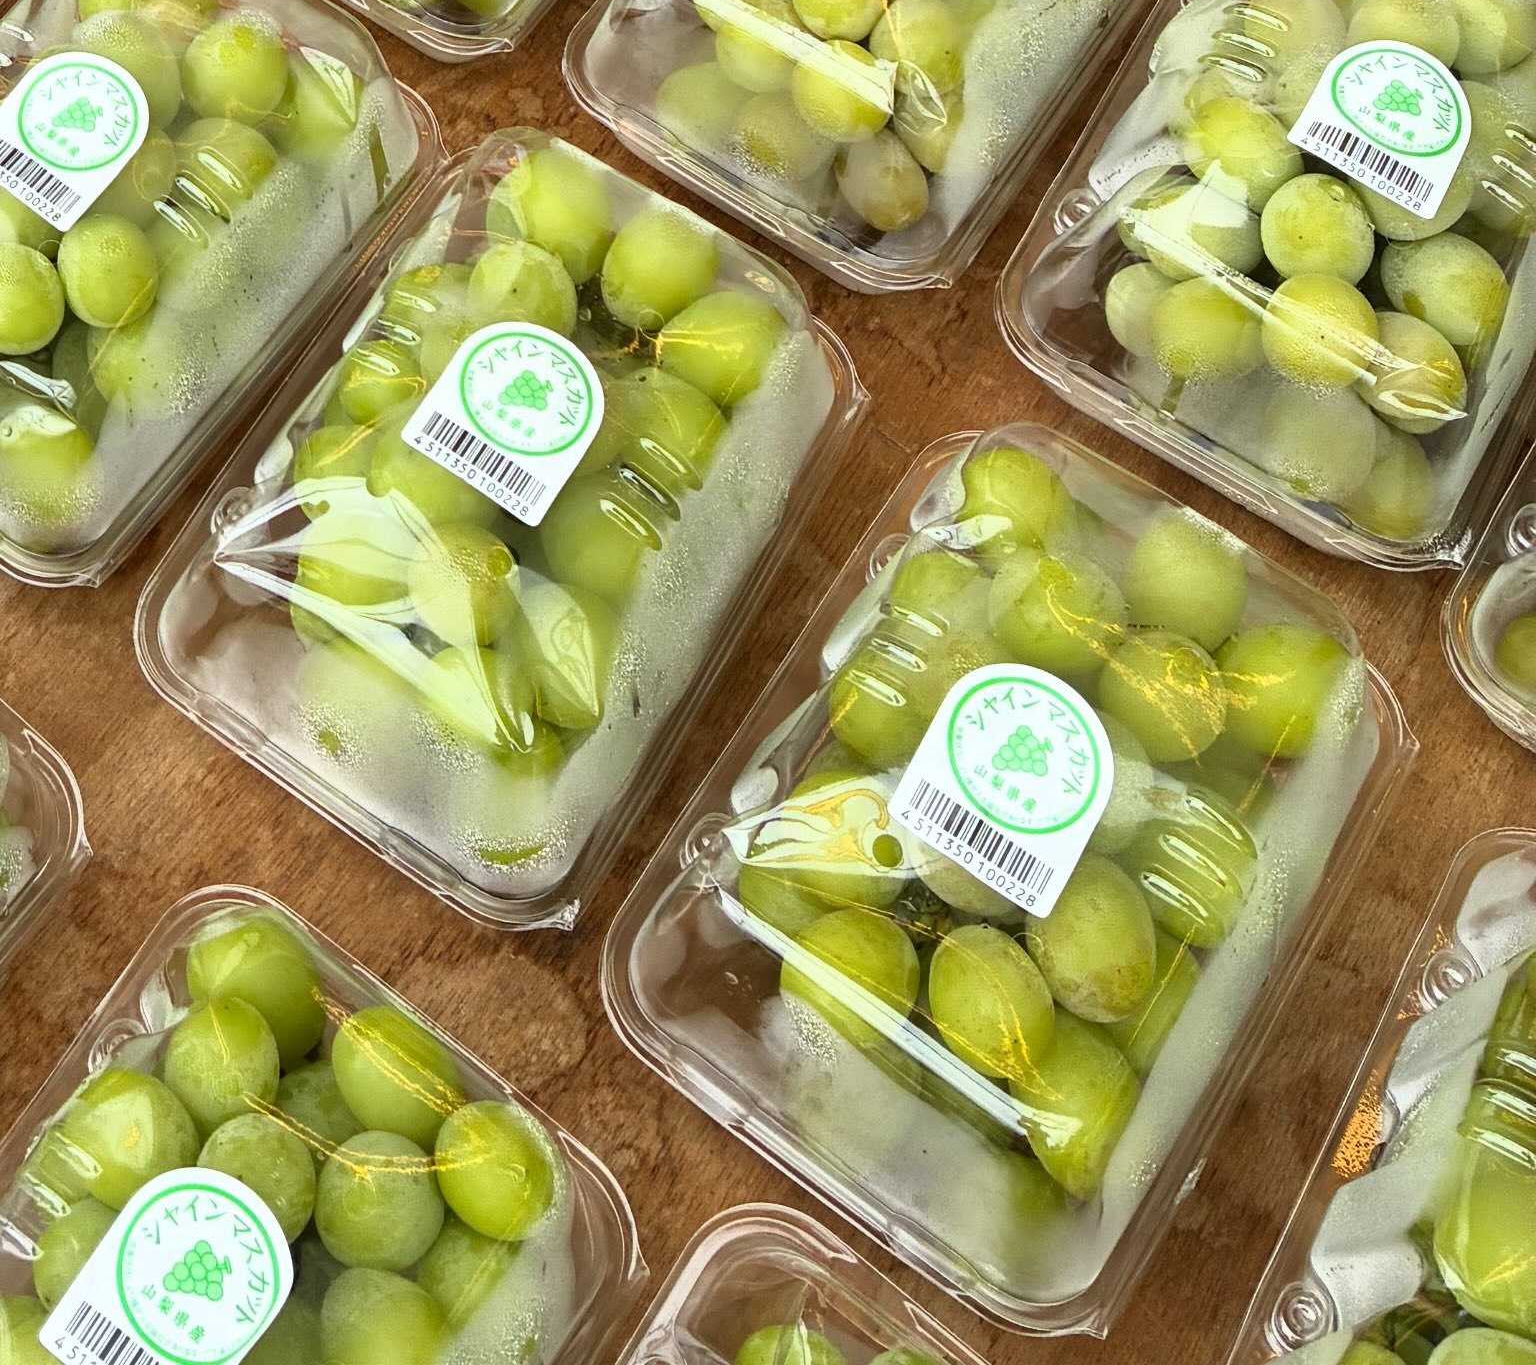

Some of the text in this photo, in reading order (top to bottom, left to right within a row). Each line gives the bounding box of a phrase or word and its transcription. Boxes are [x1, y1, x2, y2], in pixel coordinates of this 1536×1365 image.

[39, 72, 133, 148] シャインマスカット
[1345, 54, 1454, 134] シャインマスカット
[1357, 105, 1417, 142] 山梨県産
[33, 121, 81, 158] 山梨県産
[476, 340, 588, 428] シャインマスカット
[480, 398, 537, 437] 山梨県産
[964, 686, 1091, 796] シャインマスカット
[974, 763, 1038, 814] 山梨県産
[141, 1195, 271, 1325] シャインマスカット
[141, 1283, 207, 1345] 山梨県産
